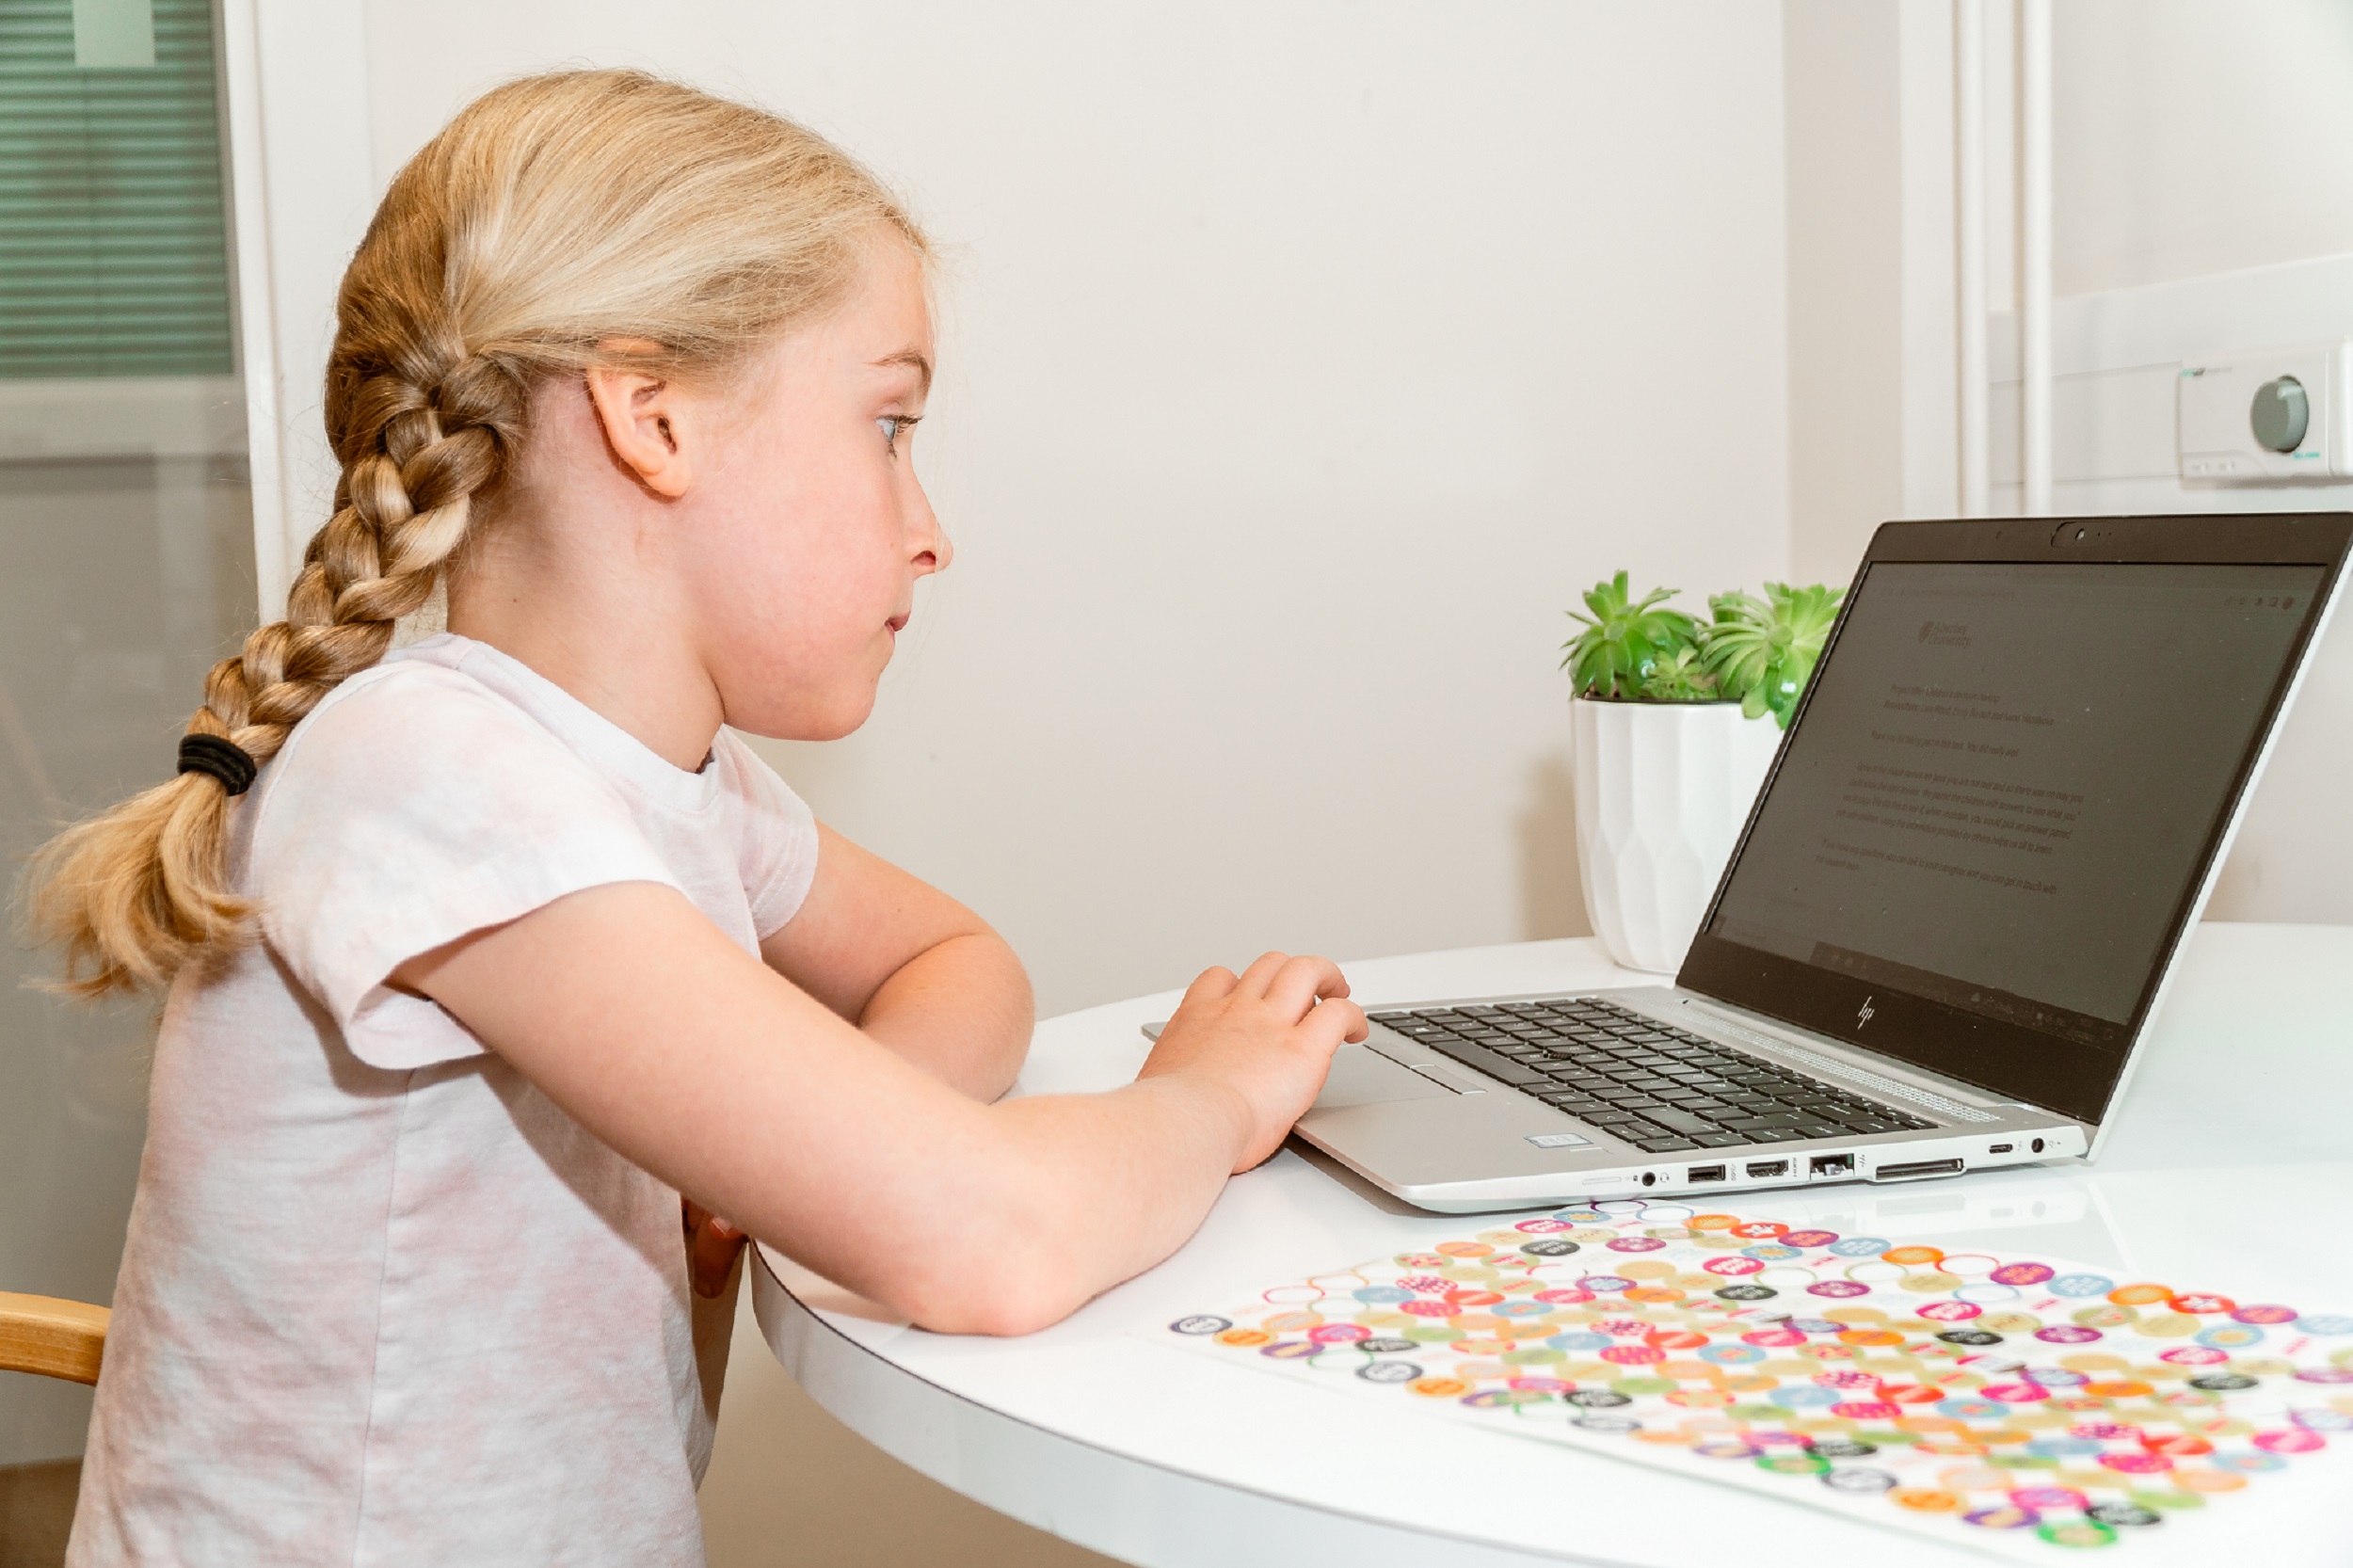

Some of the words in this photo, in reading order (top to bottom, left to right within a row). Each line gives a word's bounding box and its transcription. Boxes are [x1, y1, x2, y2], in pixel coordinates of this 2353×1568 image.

[1928, 634, 1972, 648] University
[1961, 796, 1984, 805] children
[1998, 803, 2024, 811] answers
[1906, 822, 1936, 832] information
[1936, 827, 1961, 840] provided
[1972, 833, 1991, 842] others
[2025, 825, 2048, 834] answer
[2049, 828, 2071, 840] paired
[1938, 863, 1965, 876] caregiver
[2024, 880, 2042, 890] touch
[1858, 996, 1875, 1030] hp
